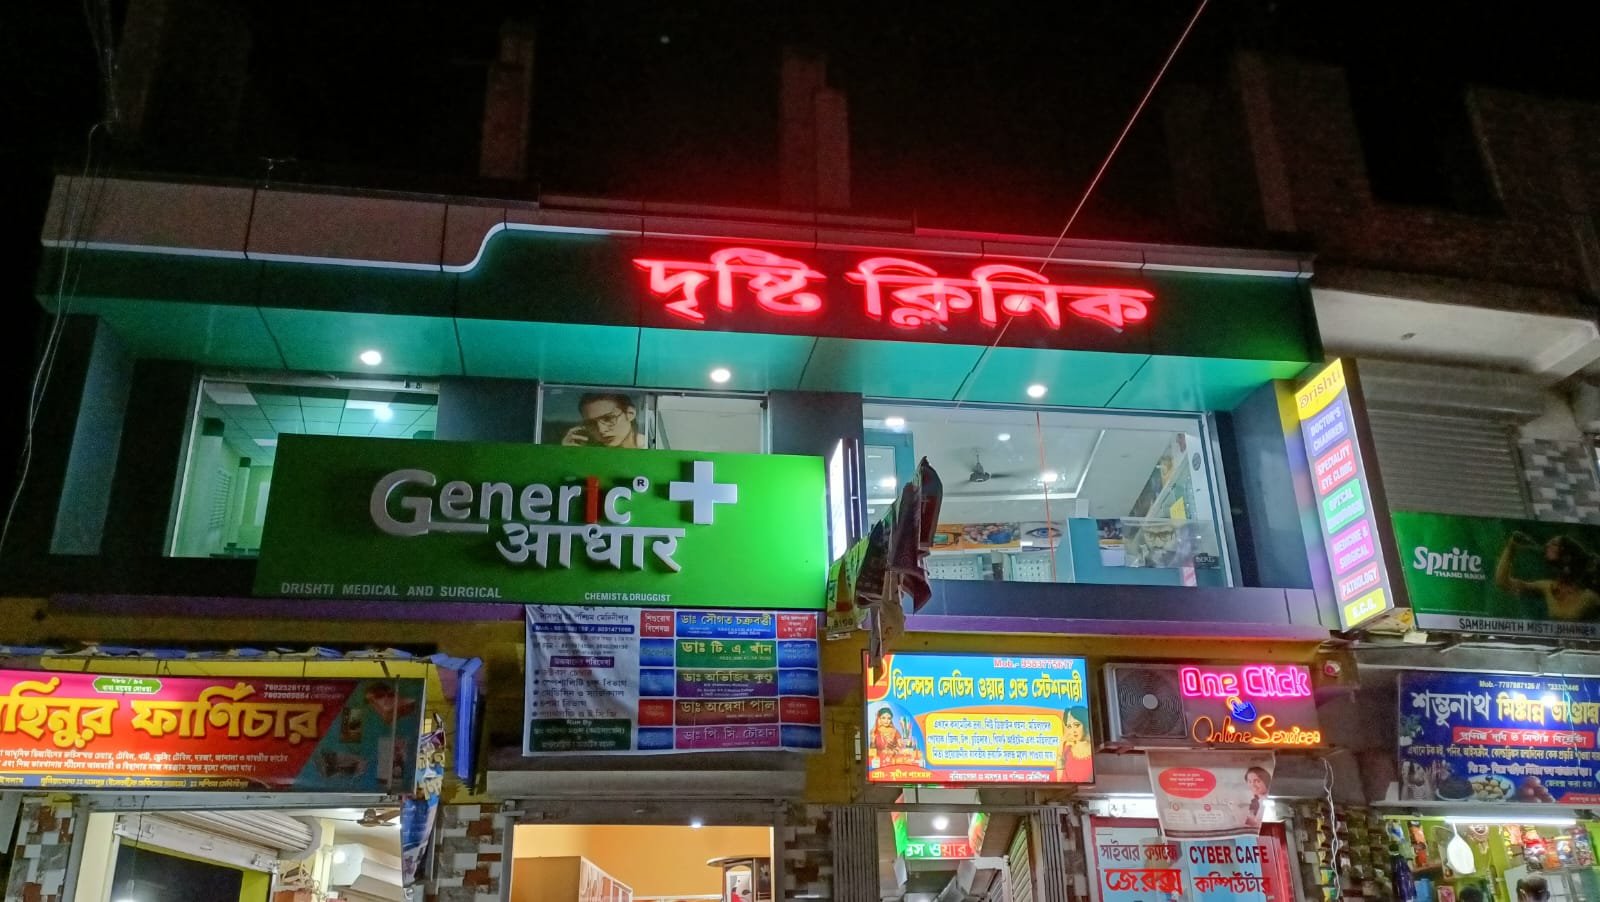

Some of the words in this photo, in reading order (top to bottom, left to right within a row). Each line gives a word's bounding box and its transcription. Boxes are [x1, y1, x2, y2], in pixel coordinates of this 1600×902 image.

[632, 246, 827, 323] দৃষ্টি
[844, 256, 1155, 328] ক্লিনিক
[1313, 422, 1344, 451] CHAMBER
[1318, 445, 1350, 475] SPECIALITY
[1321, 475, 1333, 490] EYE
[1333, 461, 1353, 480] CLINIC
[496, 522, 686, 573] आधार
[1412, 546, 1482, 576] Sprite
[1342, 567, 1377, 597] PATHOLOGY
[1434, 570, 1463, 578] THAND
[280, 582, 334, 595] DRISHTI
[342, 583, 400, 597] MEDICAL
[407, 585, 434, 597] AND
[440, 586, 503, 599] SURGICAL
[681, 614, 697, 625] ডাঃ
[701, 612, 733, 625] সৌগত
[1459, 617, 1524, 633] SAMBHUNATH
[1527, 622, 1554, 635] MISTI
[681, 641, 705, 654] ডাঃ
[711, 641, 727, 654] টি.
[682, 672, 702, 683] ডাঃ
[704, 671, 751, 683] অভিজিৎ
[938, 668, 975, 699] লেডিস
[977, 677, 1005, 701] ওয়ার
[1181, 667, 1240, 698] One
[1242, 666, 1312, 698] Click
[130, 682, 324, 745] ফার্ণিচার
[680, 701, 702, 713] ডাঃ
[750, 699, 777, 713] পাল
[1411, 689, 1492, 728] শম্ভুনাথ
[681, 729, 702, 741] ডাঃ
[1192, 716, 1252, 744] Online
[929, 843, 967, 857] ওয়ার
[1099, 839, 1140, 862] সাইবার
[1189, 845, 1234, 864] CYBER
[1236, 845, 1270, 864] CAFE
[1103, 868, 1183, 896] জেরক্স
[1193, 870, 1273, 894] কম্পিউটার
